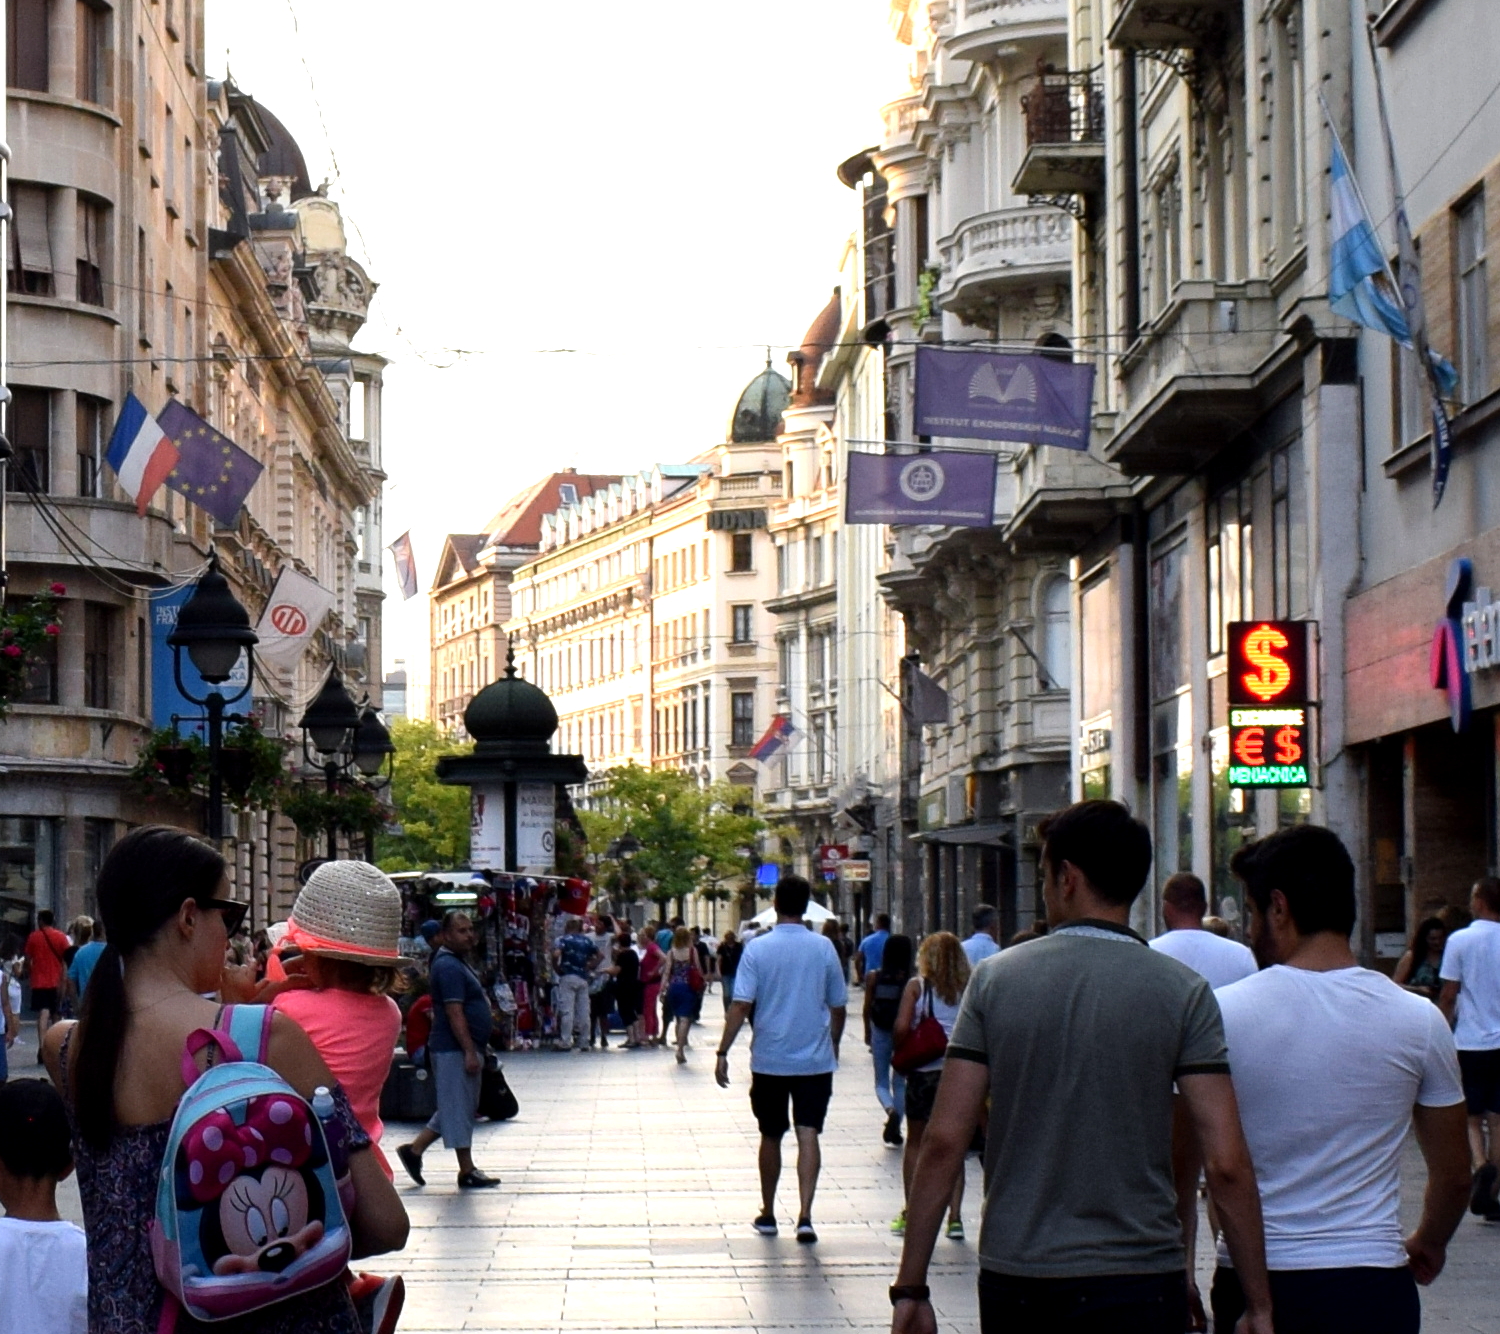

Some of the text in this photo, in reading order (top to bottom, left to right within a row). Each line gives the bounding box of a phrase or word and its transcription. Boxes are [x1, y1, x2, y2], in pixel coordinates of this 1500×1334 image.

[1244, 625, 1291, 702] $
[1234, 725, 1302, 766] € $
